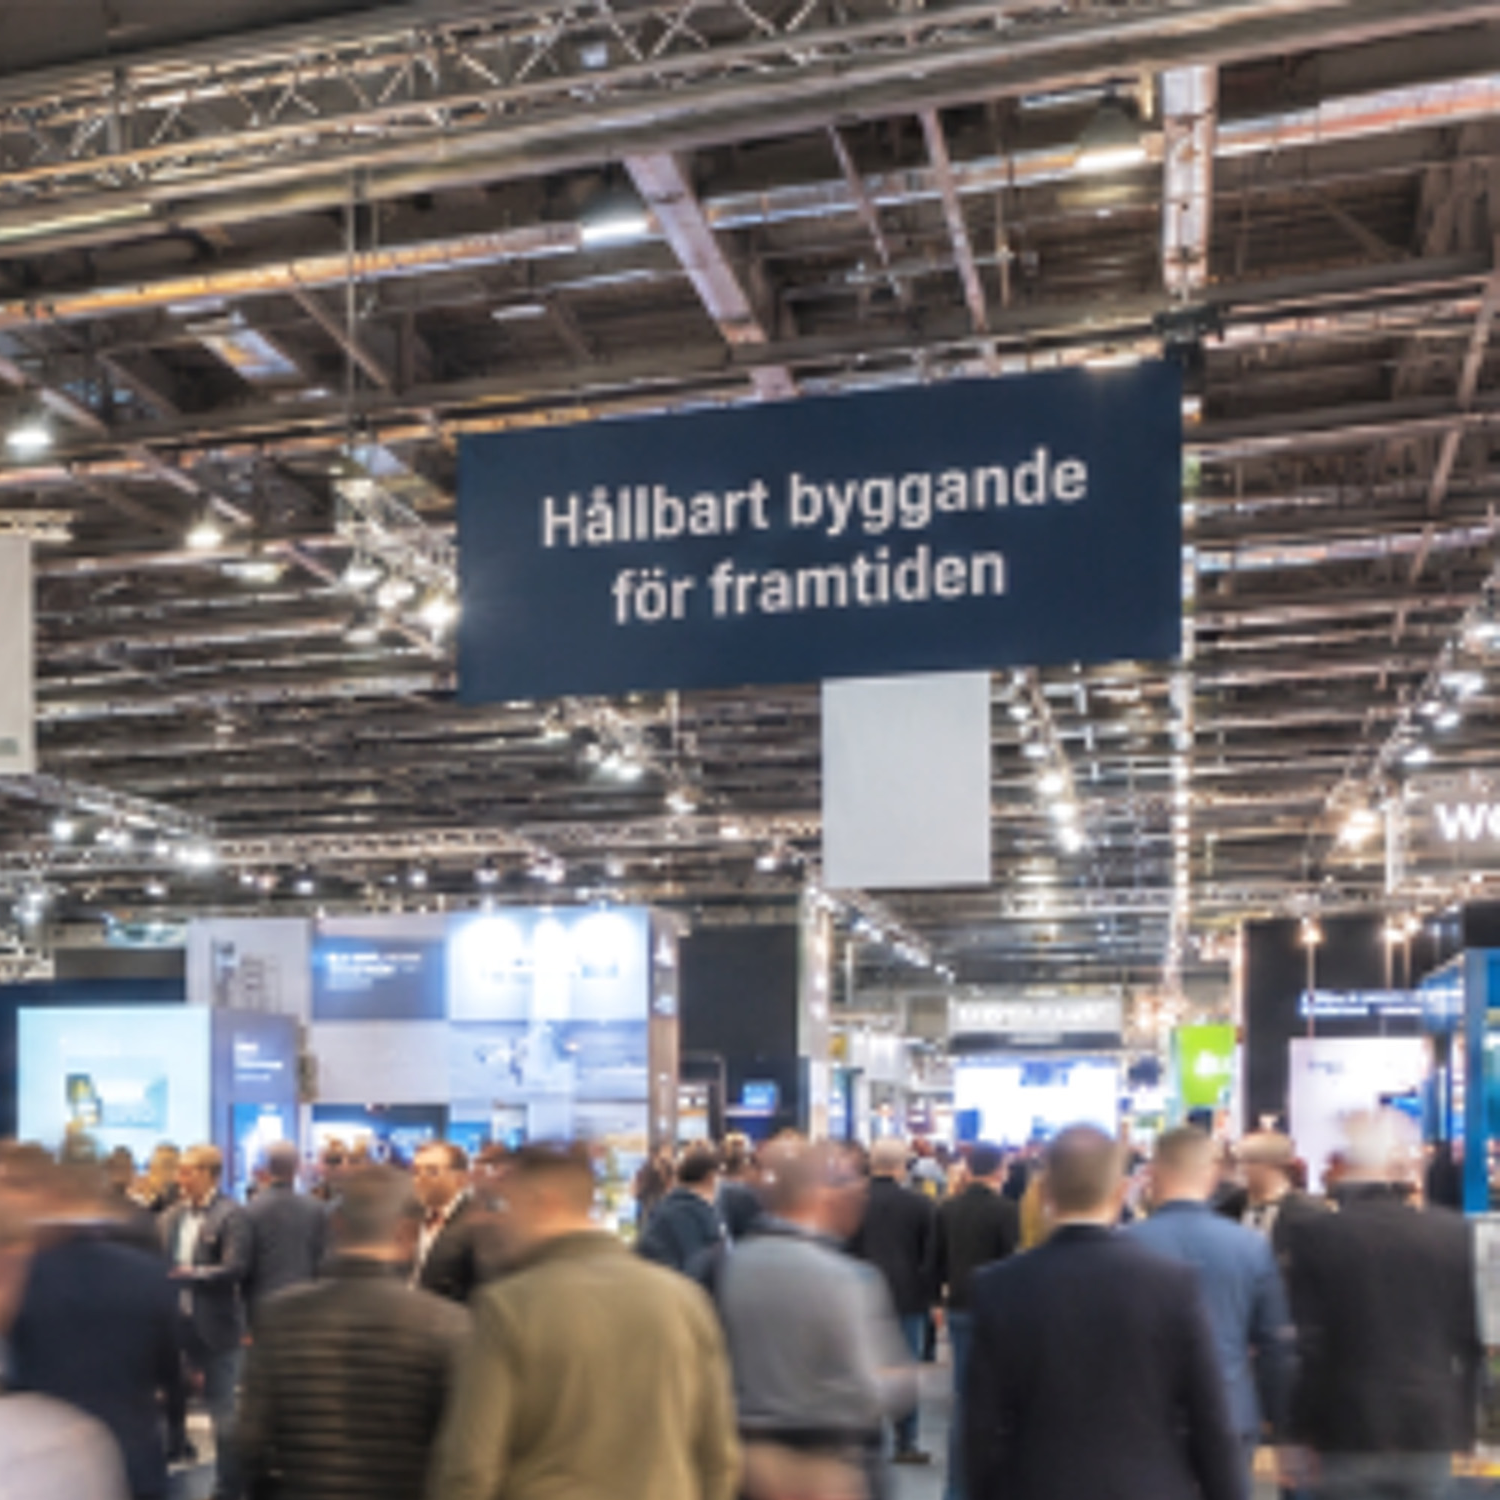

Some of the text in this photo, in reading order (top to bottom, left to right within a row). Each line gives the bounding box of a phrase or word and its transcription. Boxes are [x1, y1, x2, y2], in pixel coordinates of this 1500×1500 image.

[542, 444, 1089, 548] Hållbart byggande
[611, 543, 1006, 625] för framtiden
